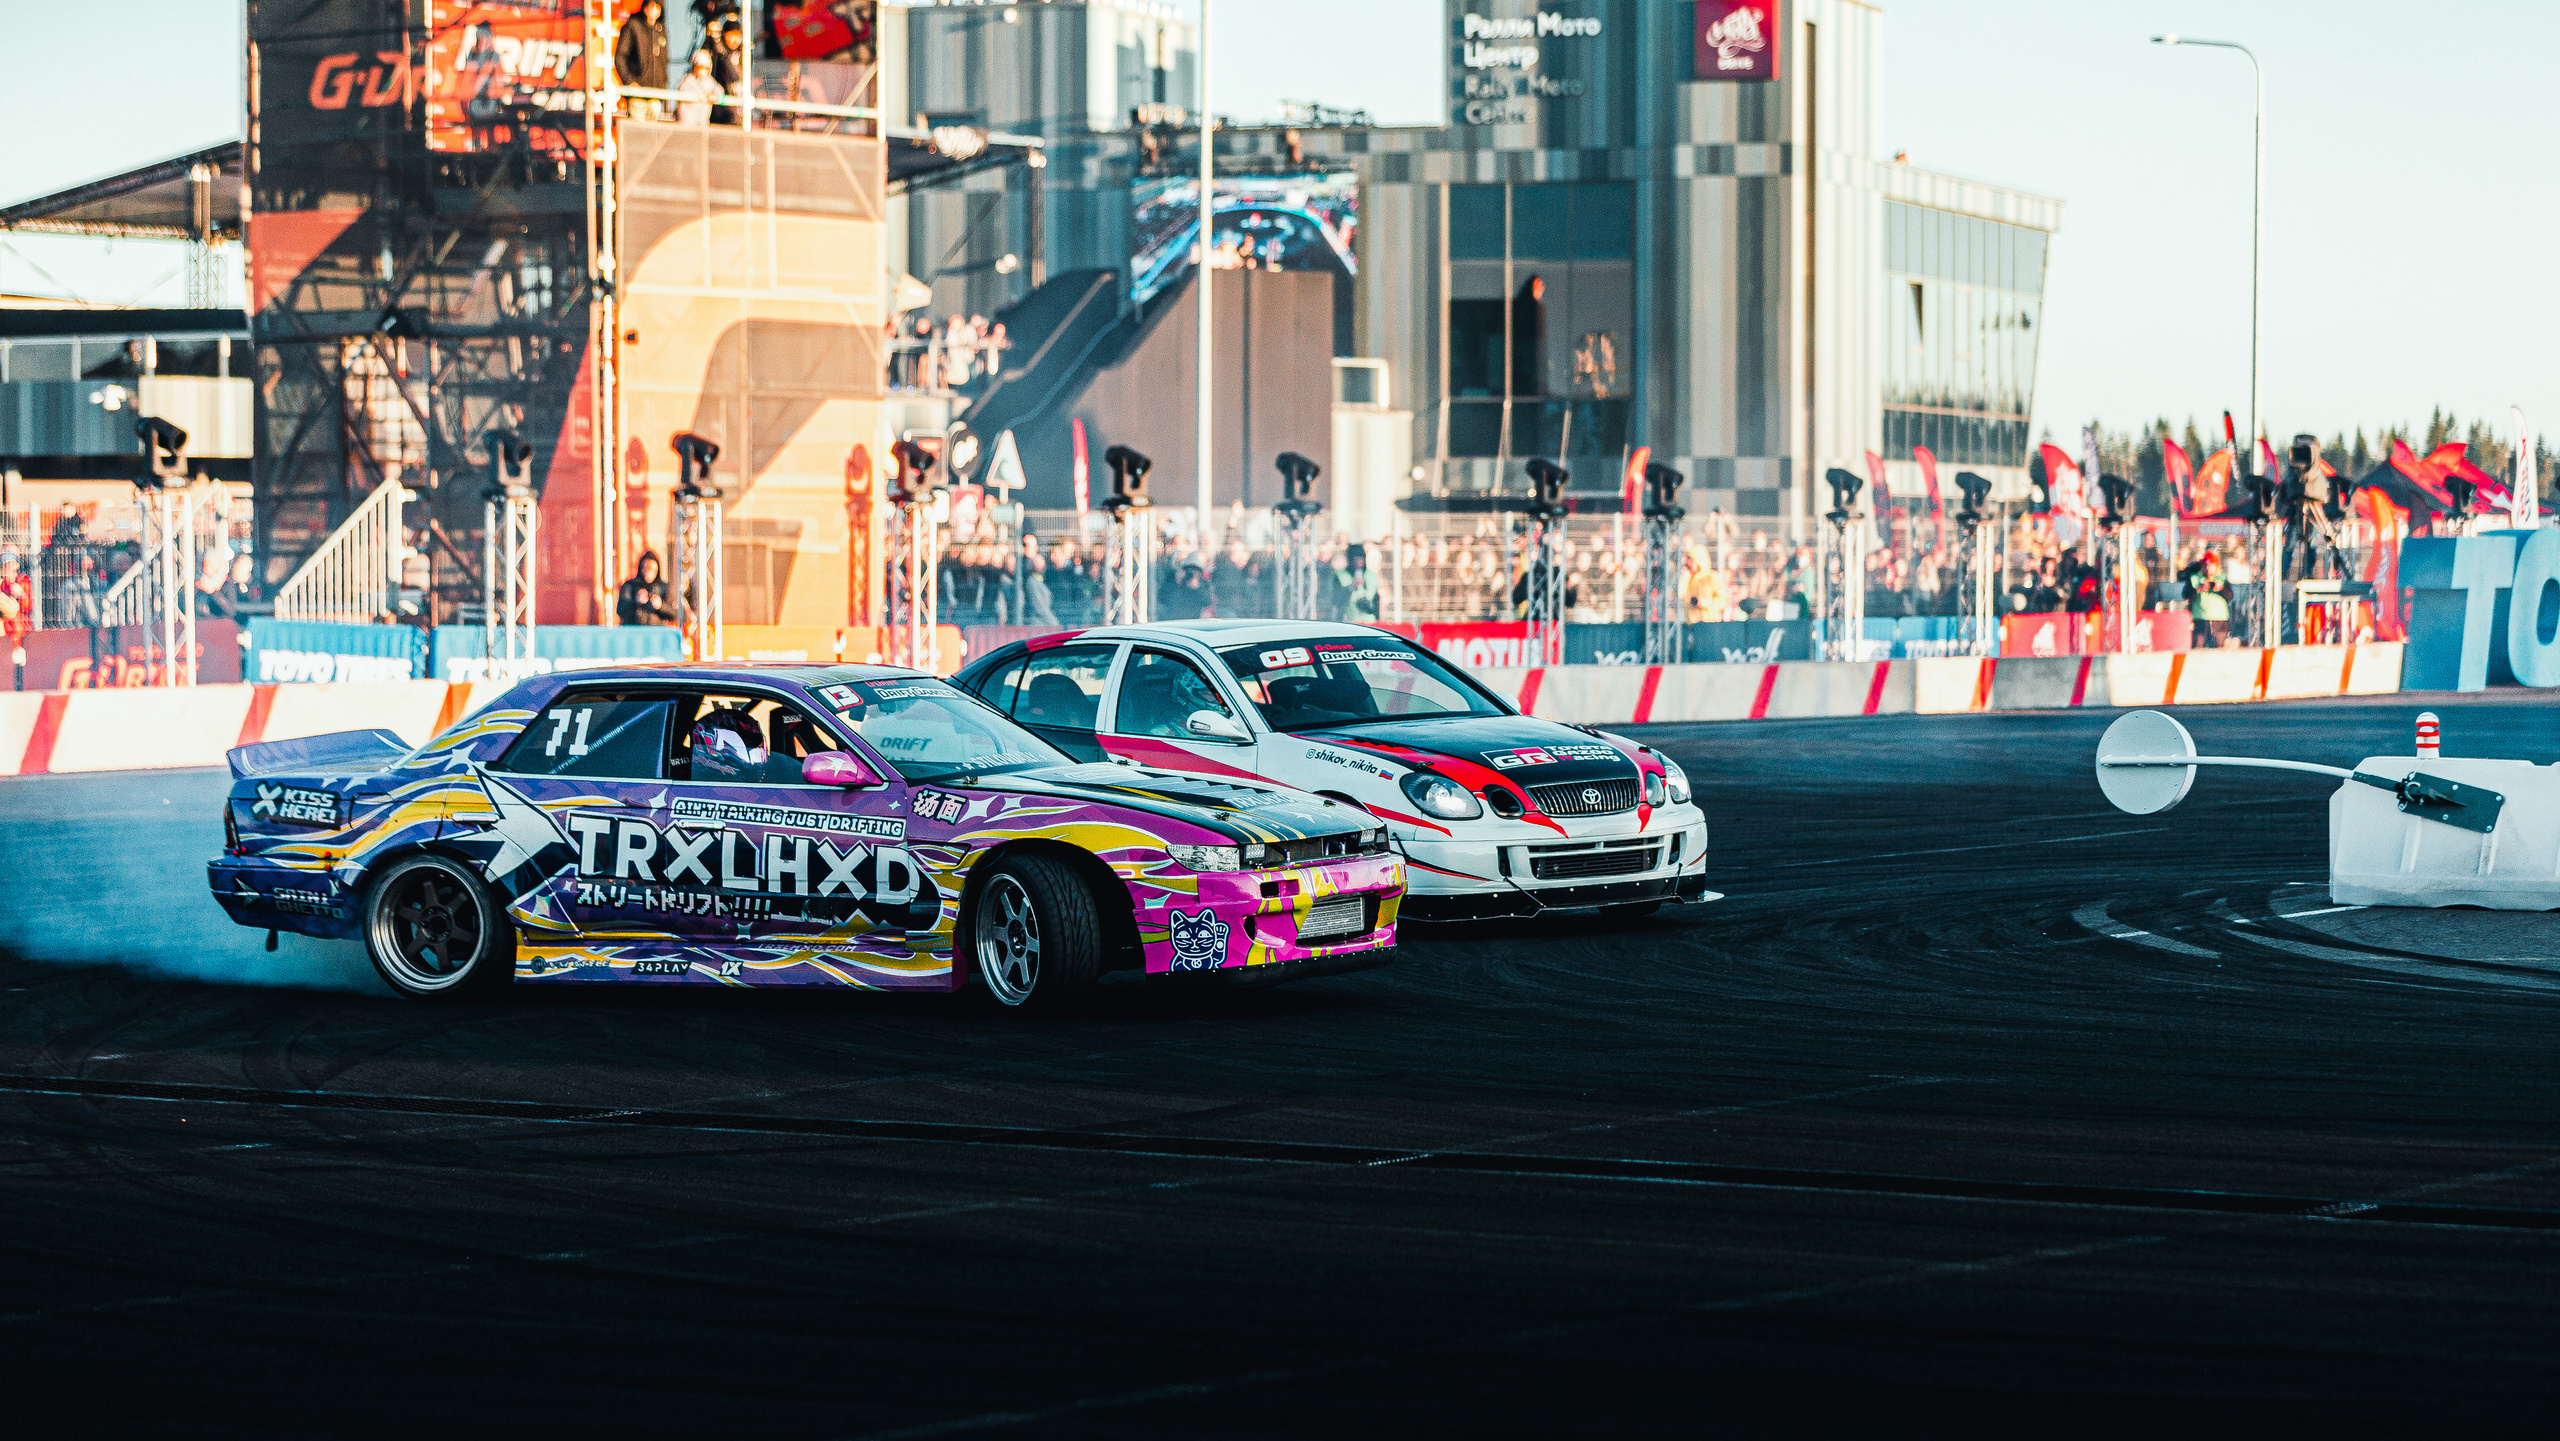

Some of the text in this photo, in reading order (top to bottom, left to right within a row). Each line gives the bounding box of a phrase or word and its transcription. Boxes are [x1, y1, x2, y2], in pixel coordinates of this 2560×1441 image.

[1464, 11, 1602, 39] Ралли Мото
[1464, 41, 1539, 70] Центр
[259, 650, 334, 683] TOYO
[1259, 647, 1314, 668] 09
[1321, 650, 1415, 662] DRIFT GAMES
[877, 687, 916, 699] DRIFT
[546, 708, 592, 756] 71
[880, 737, 932, 751] DRIFT
[1492, 752, 1557, 768] GR
[1559, 754, 1621, 762] Racing
[284, 788, 335, 807] KISS
[280, 802, 337, 824] HERE!
[675, 800, 903, 836] AIN'T TALKING JUST DRIFTING
[569, 815, 922, 906] TRXLHXD
[720, 961, 742, 975] 1X
